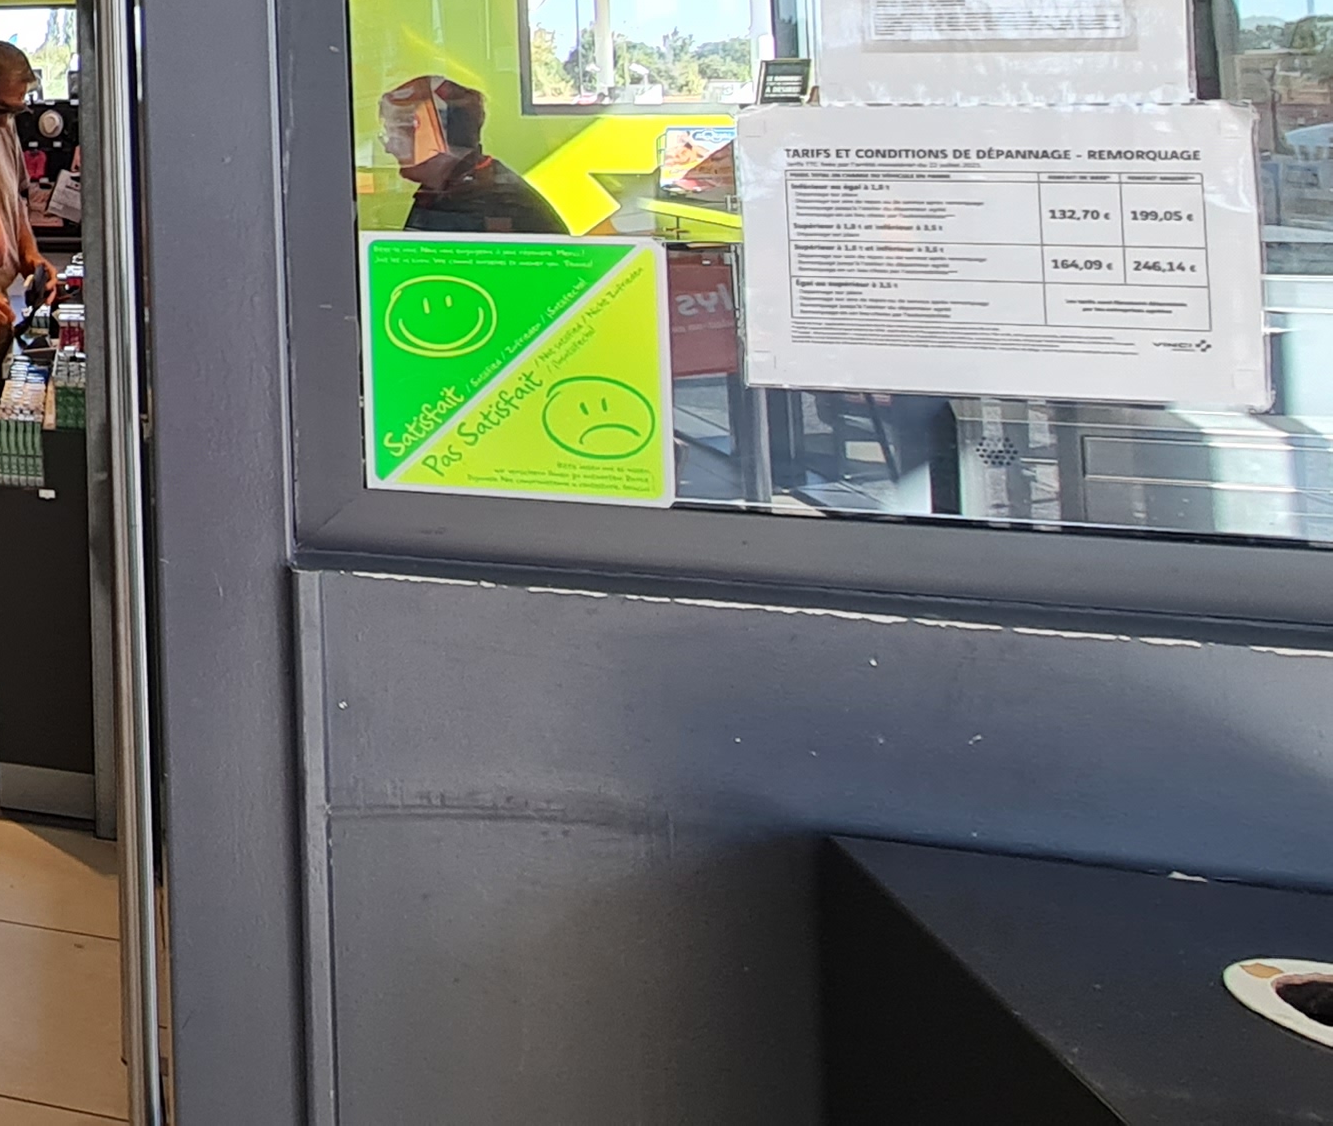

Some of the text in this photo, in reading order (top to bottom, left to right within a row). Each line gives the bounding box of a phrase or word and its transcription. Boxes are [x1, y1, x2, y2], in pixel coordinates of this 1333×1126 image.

[784, 148, 832, 159] TARIFS
[835, 148, 851, 159] ET
[855, 148, 948, 160] CONDITIONS
[952, 149, 972, 160] DE
[975, 146, 1072, 160] DÉPANNAGE
[1087, 149, 1202, 161] REMORQUAGE
[1049, 208, 1111, 221] 132,70 €
[1130, 209, 1194, 223] 199,05 €
[1052, 259, 1114, 271] 164,09 €
[1132, 260, 1197, 273] 246,14 €
[384, 384, 465, 457] Satisfait
[422, 444, 463, 477] Pas
[457, 370, 543, 446] Satisfait
